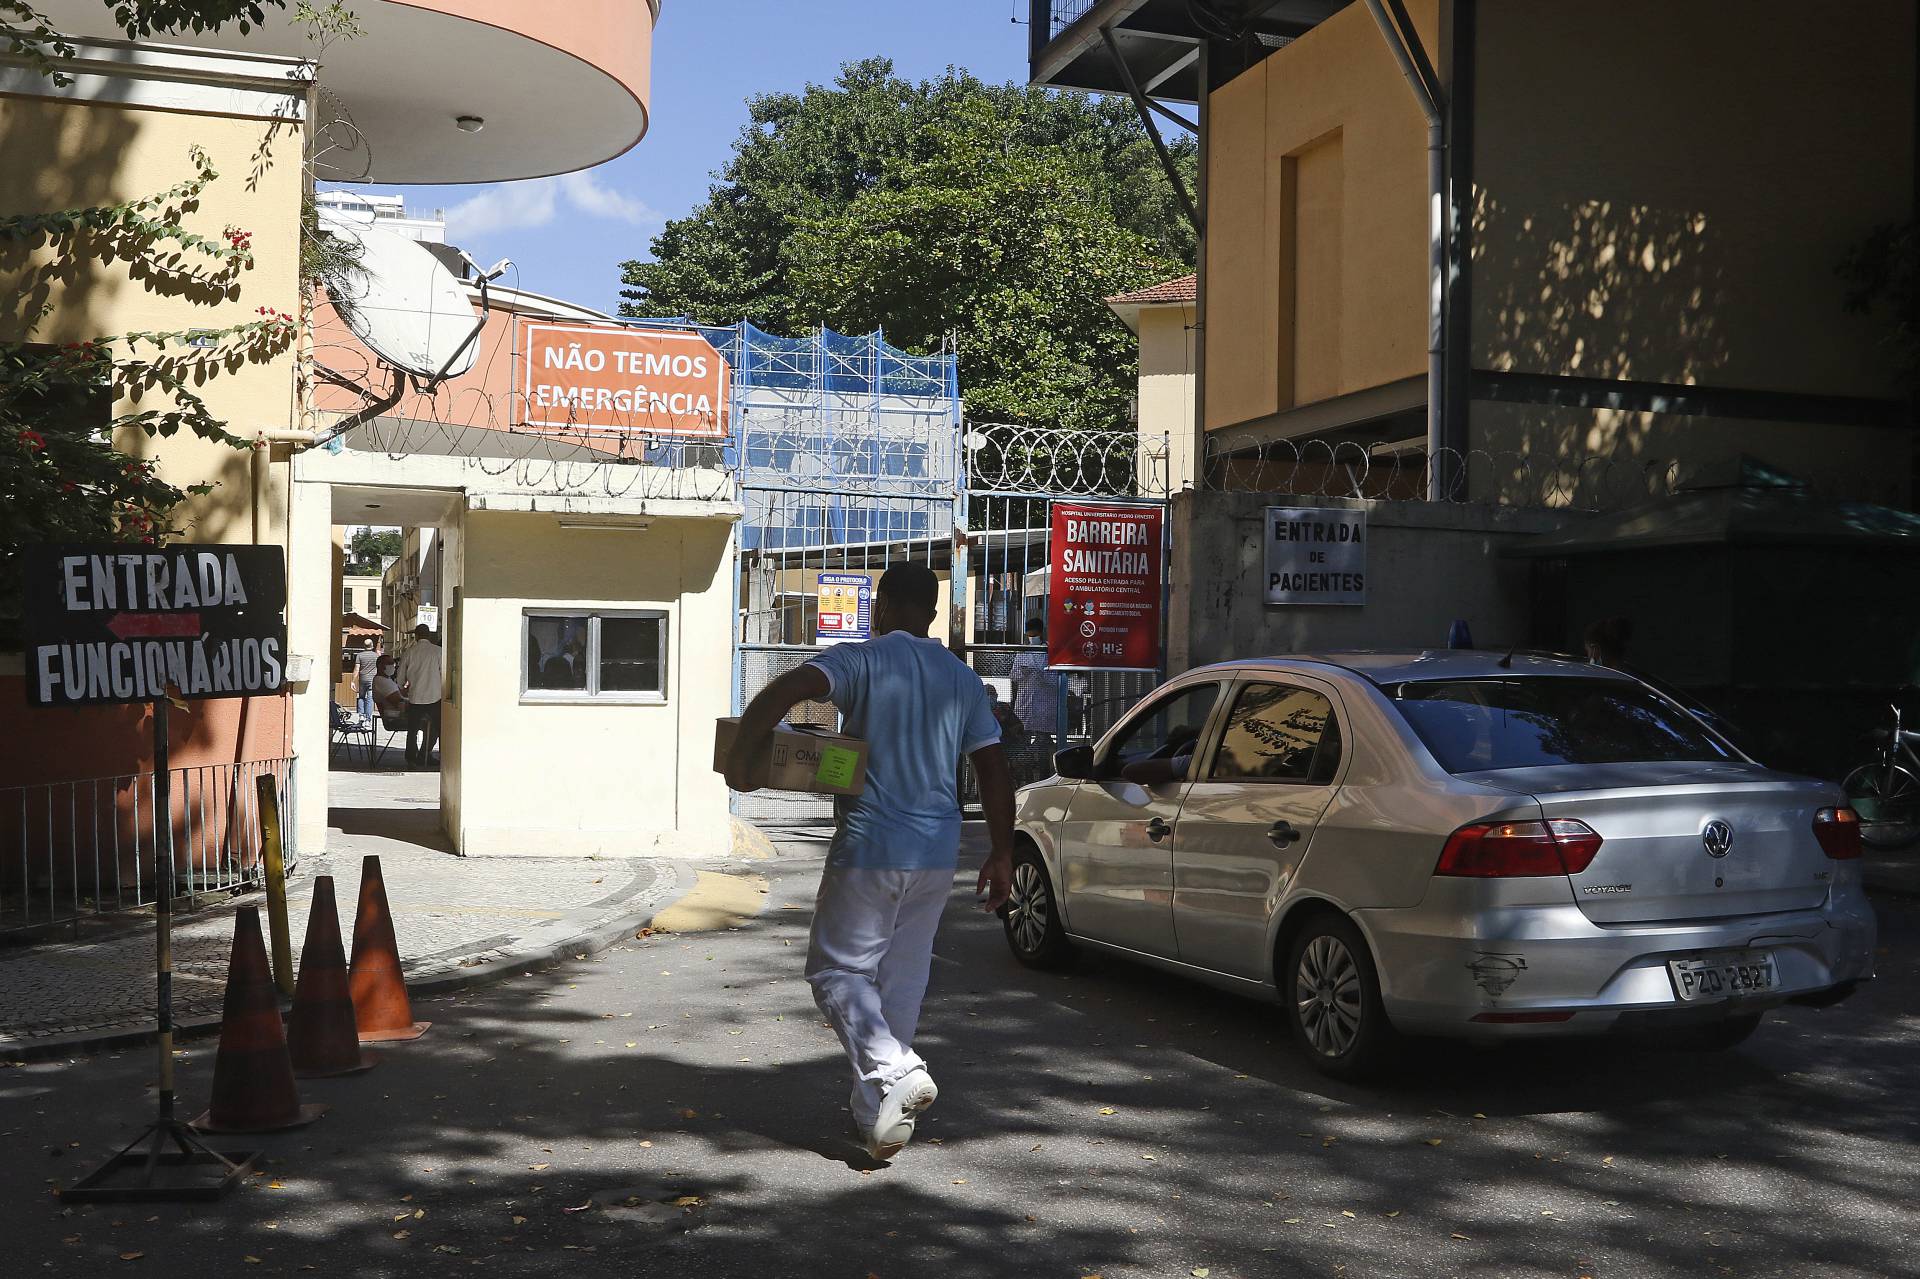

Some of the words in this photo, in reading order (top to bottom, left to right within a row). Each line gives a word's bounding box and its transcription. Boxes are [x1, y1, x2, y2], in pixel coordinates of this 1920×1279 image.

[544, 342, 605, 372] NÃO
[613, 351, 707, 379] TEMOS
[536, 384, 713, 416] EMERGÊNCIA
[1067, 519, 1148, 545] BARREIRA
[1275, 521, 1361, 543] ENTRADA
[1062, 547, 1149, 575] SANITÁRIA
[1309, 551, 1325, 563] DE
[63, 552, 248, 611] ENTRADA
[1269, 573, 1363, 591] PACIENTES
[37, 632, 281, 703] FUNCIONÁRIOS
[1583, 884, 1632, 894] VOYAGE
